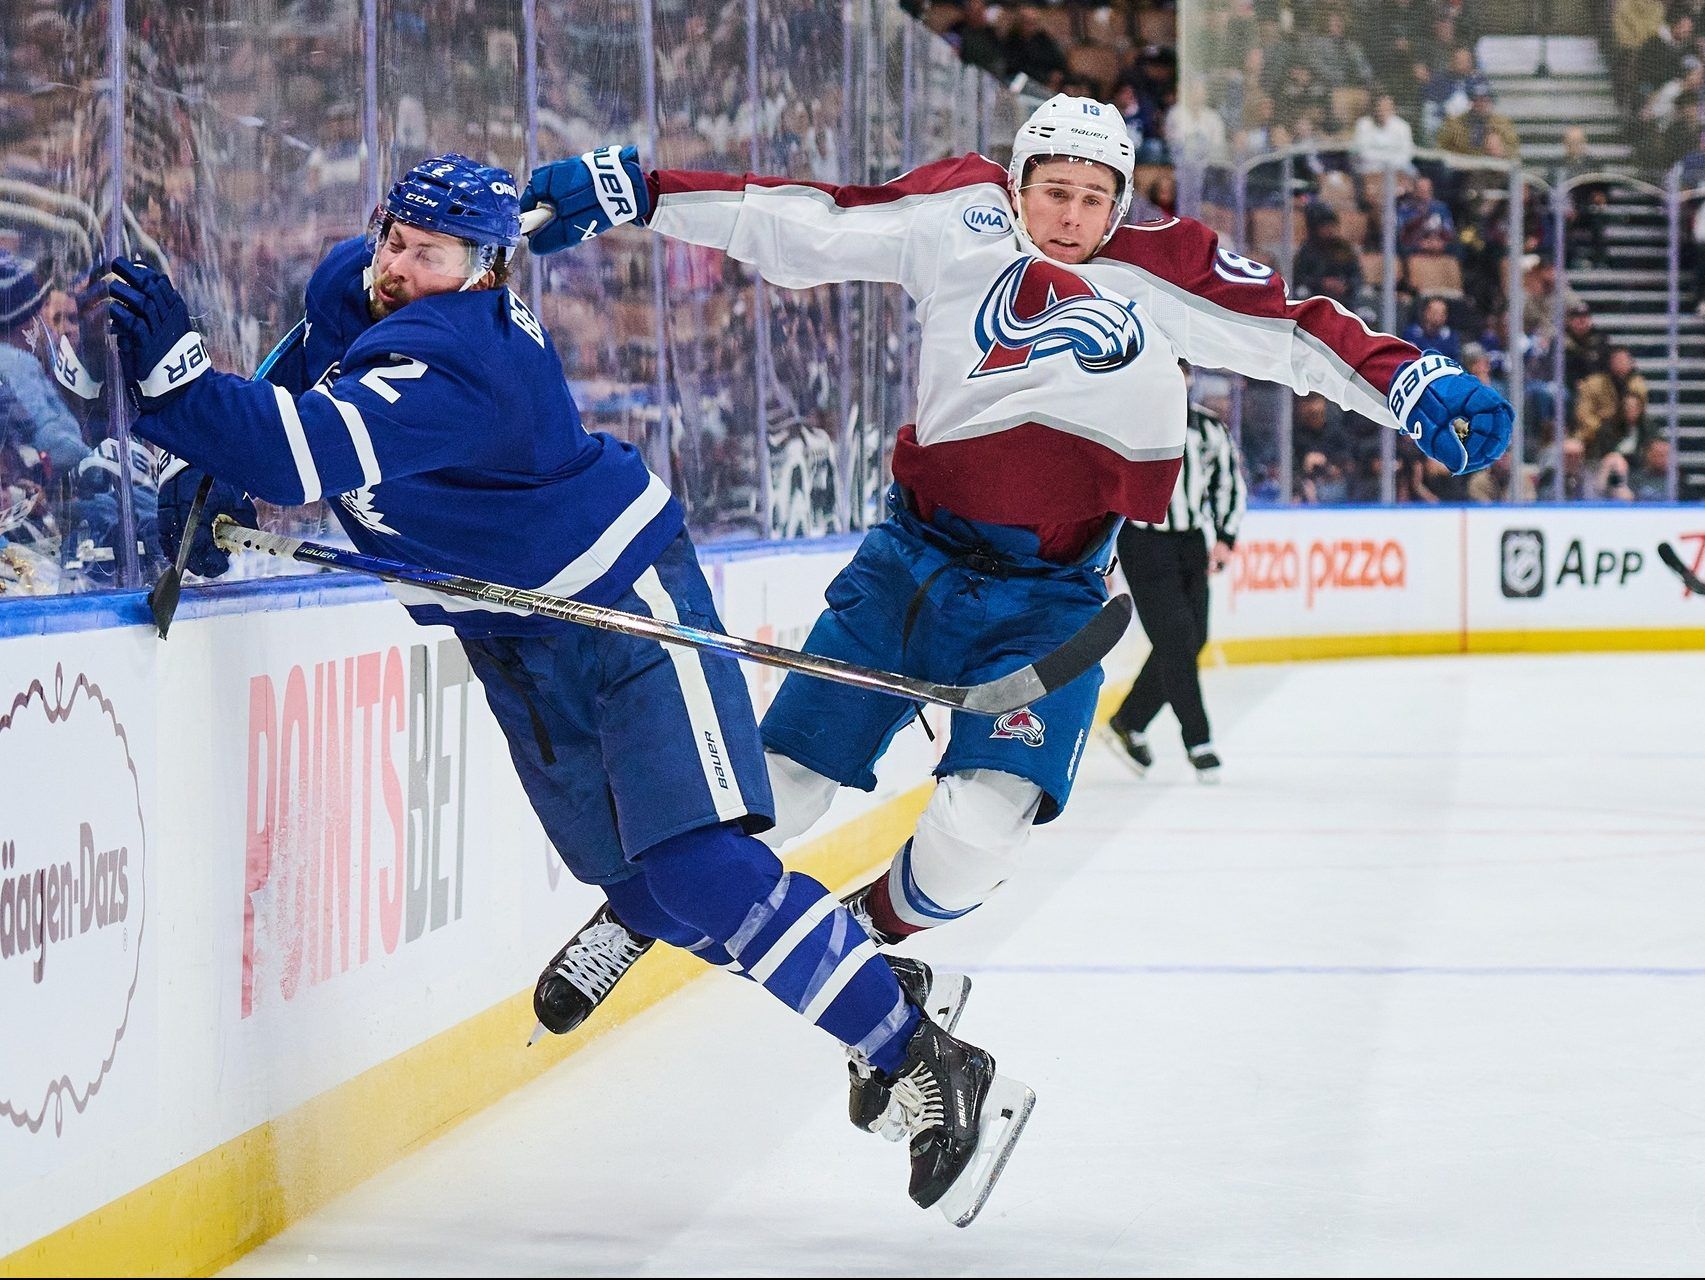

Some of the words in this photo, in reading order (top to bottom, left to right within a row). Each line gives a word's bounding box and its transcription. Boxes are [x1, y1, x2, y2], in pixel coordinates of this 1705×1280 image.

[1070, 127, 1109, 140] BAUER
[431, 164, 453, 178] 2
[405, 192, 438, 208] CCM
[969, 208, 1005, 229] IMA
[507, 287, 545, 349] BE
[359, 352, 429, 405] 2
[1307, 539, 1407, 608] pizza
[704, 730, 728, 790] BAUER
[956, 1089, 968, 1129] BAUER
